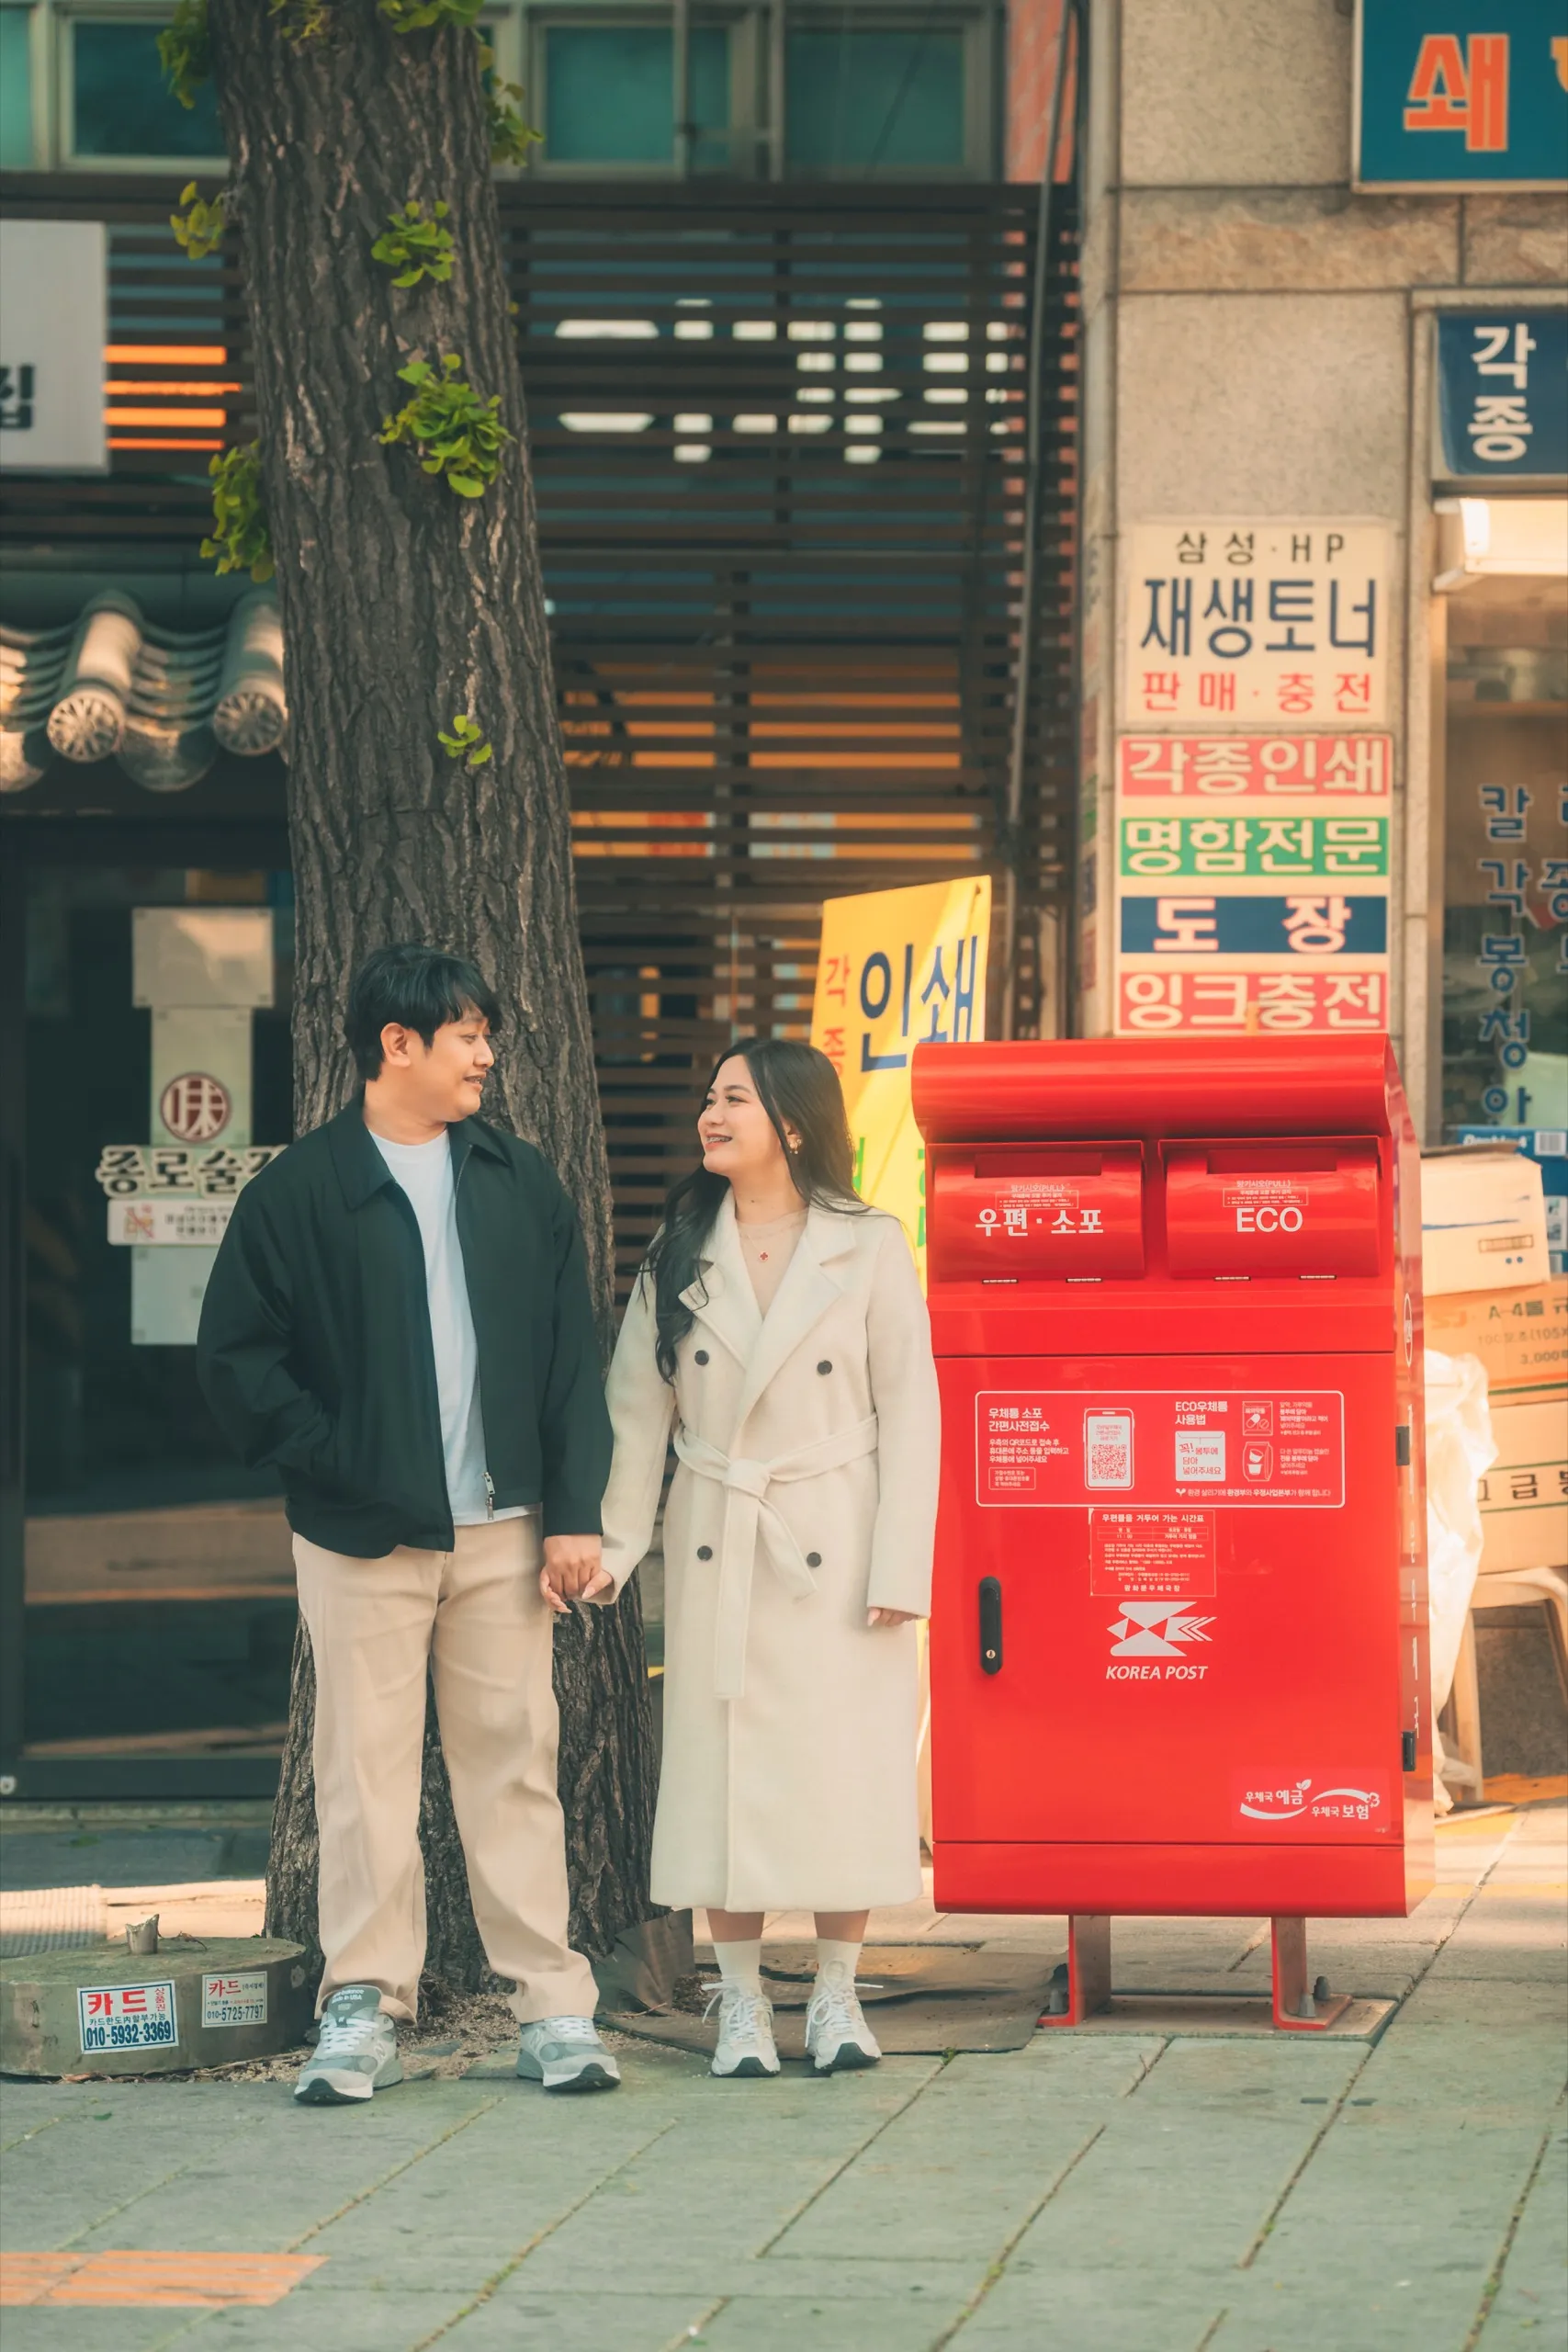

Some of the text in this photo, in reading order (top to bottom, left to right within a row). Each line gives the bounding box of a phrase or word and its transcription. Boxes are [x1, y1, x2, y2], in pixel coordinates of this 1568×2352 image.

[1404, 33, 1509, 151] 쇄
[1468, 322, 1537, 461] 각종
[1140, 577, 1376, 660] 재생토너
[1127, 739, 1384, 795] 각종인쇄
[1125, 819, 1383, 875] 명함전문
[860, 934, 978, 1072] 인쇄
[1124, 973, 1383, 1031] 잉크충전
[1236, 1206, 1303, 1232] ECO
[988, 1420, 1050, 1431] 간편사전접수
[989, 1408, 1043, 1419] 우체통 소포
[1175, 1414, 1206, 1425] 사용법
[1136, 1514, 1159, 1522] 거두어
[1163, 1514, 1178, 1522] 가는
[1181, 1514, 1204, 1522] 시간표
[1105, 1665, 1209, 1679] KOREA POST
[1246, 1790, 1303, 1805] 우체국 예금
[1311, 1804, 1370, 1820] 우체국 보험
[209, 1979, 241, 1998] 카드
[87, 1989, 147, 2016] 카드
[207, 2005, 264, 2021] 010-5725-7797
[86, 2020, 172, 2047] 010-5932-3369
